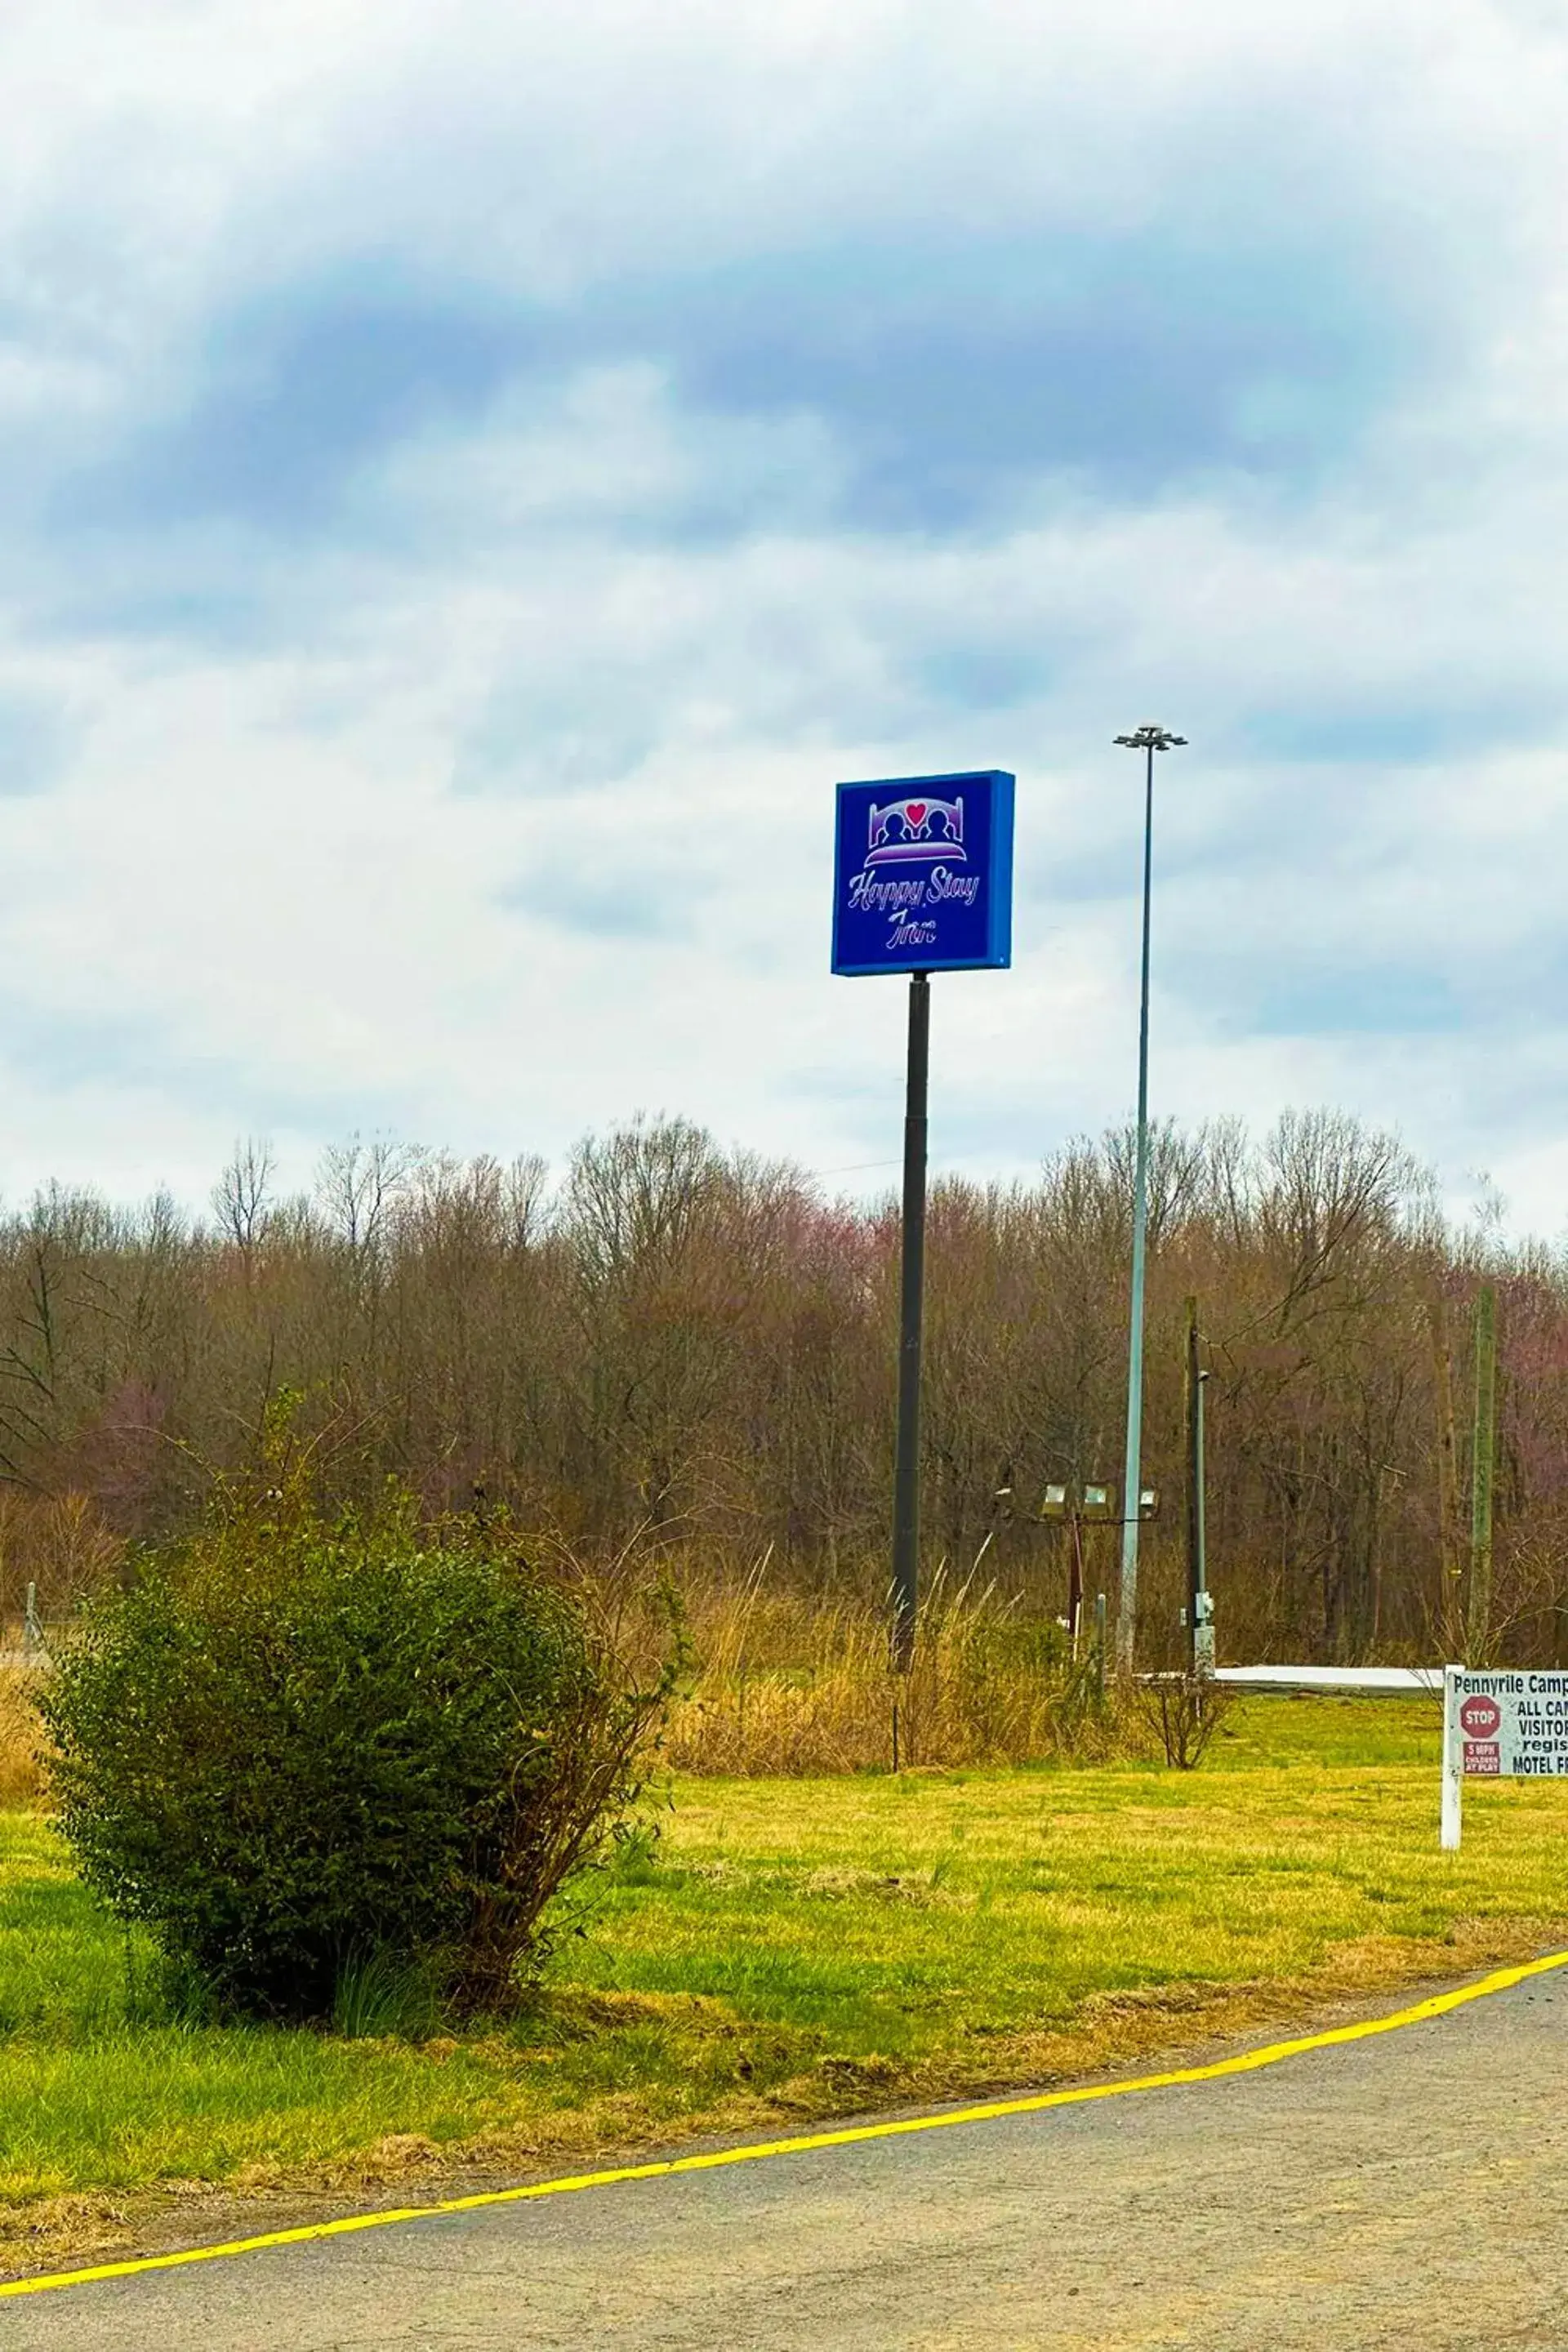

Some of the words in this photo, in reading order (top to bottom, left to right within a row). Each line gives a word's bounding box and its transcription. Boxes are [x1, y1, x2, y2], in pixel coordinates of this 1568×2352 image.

[848, 870, 925, 911] Happy
[927, 866, 980, 905] Stay
[886, 909, 936, 949] Inn
[1454, 1674, 1523, 1696] Pennyrile
[1466, 1710, 1495, 1725] STOP
[1517, 1701, 1541, 1716] ALL
[1512, 1756, 1553, 1774] MOTEL
